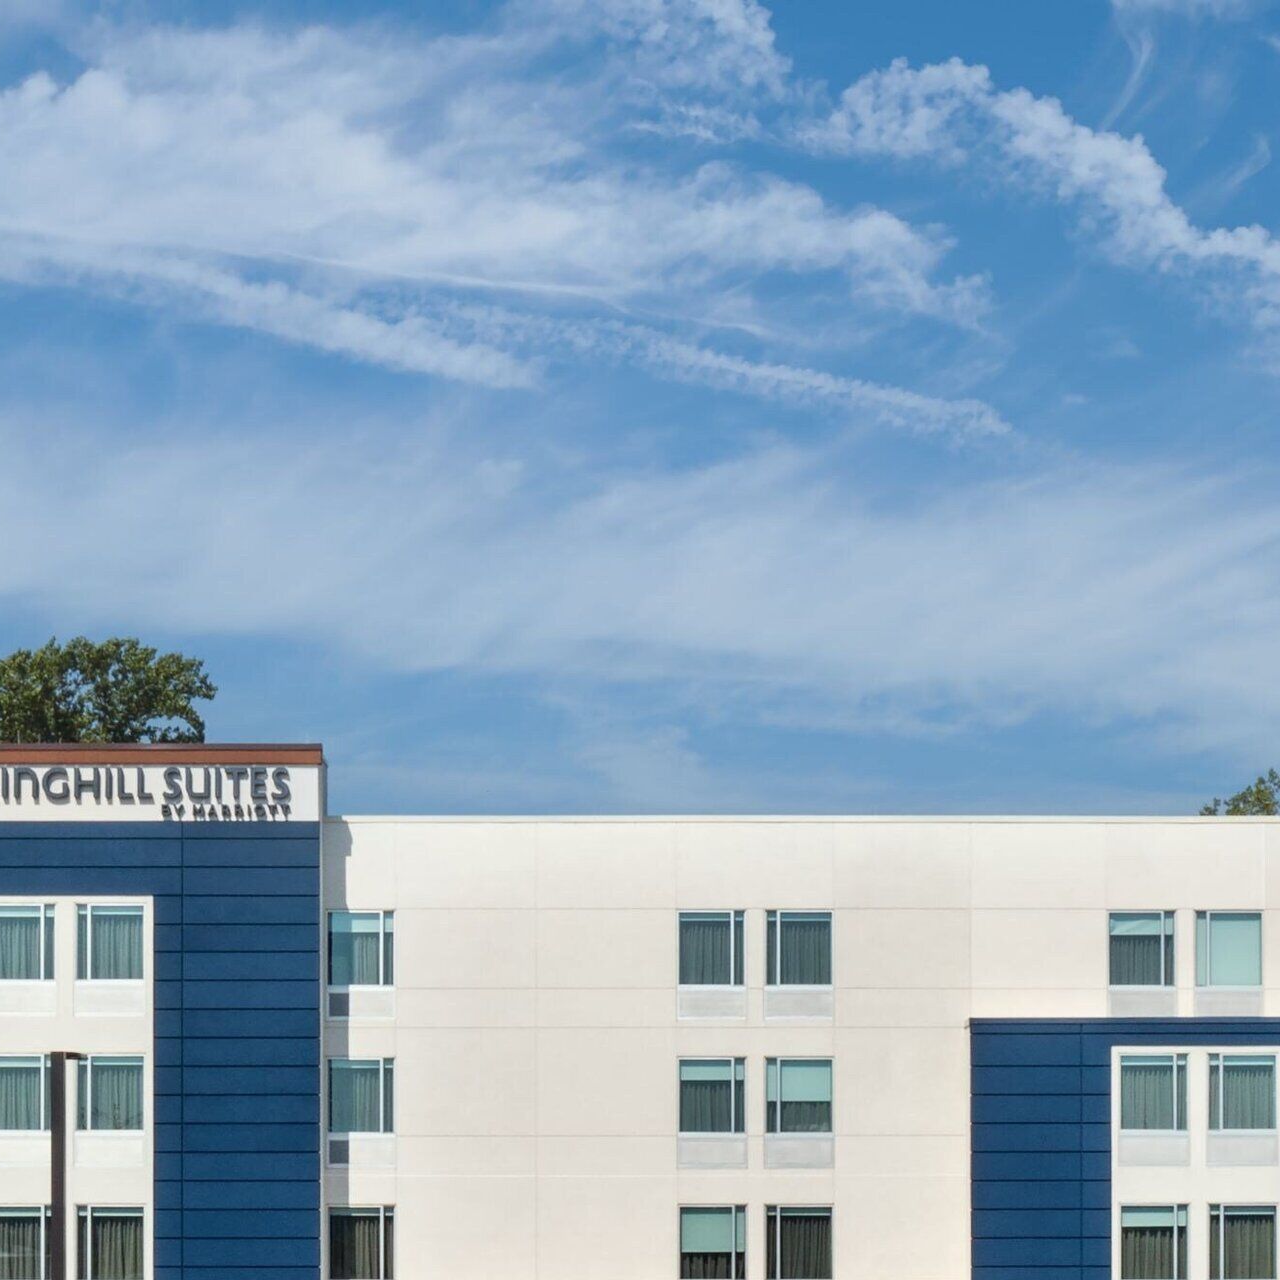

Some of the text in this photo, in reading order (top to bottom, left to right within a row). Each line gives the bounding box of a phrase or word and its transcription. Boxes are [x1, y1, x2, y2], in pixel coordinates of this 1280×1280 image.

[162, 767, 292, 803] SUITES
[161, 804, 292, 820] BY MARRIOTT
